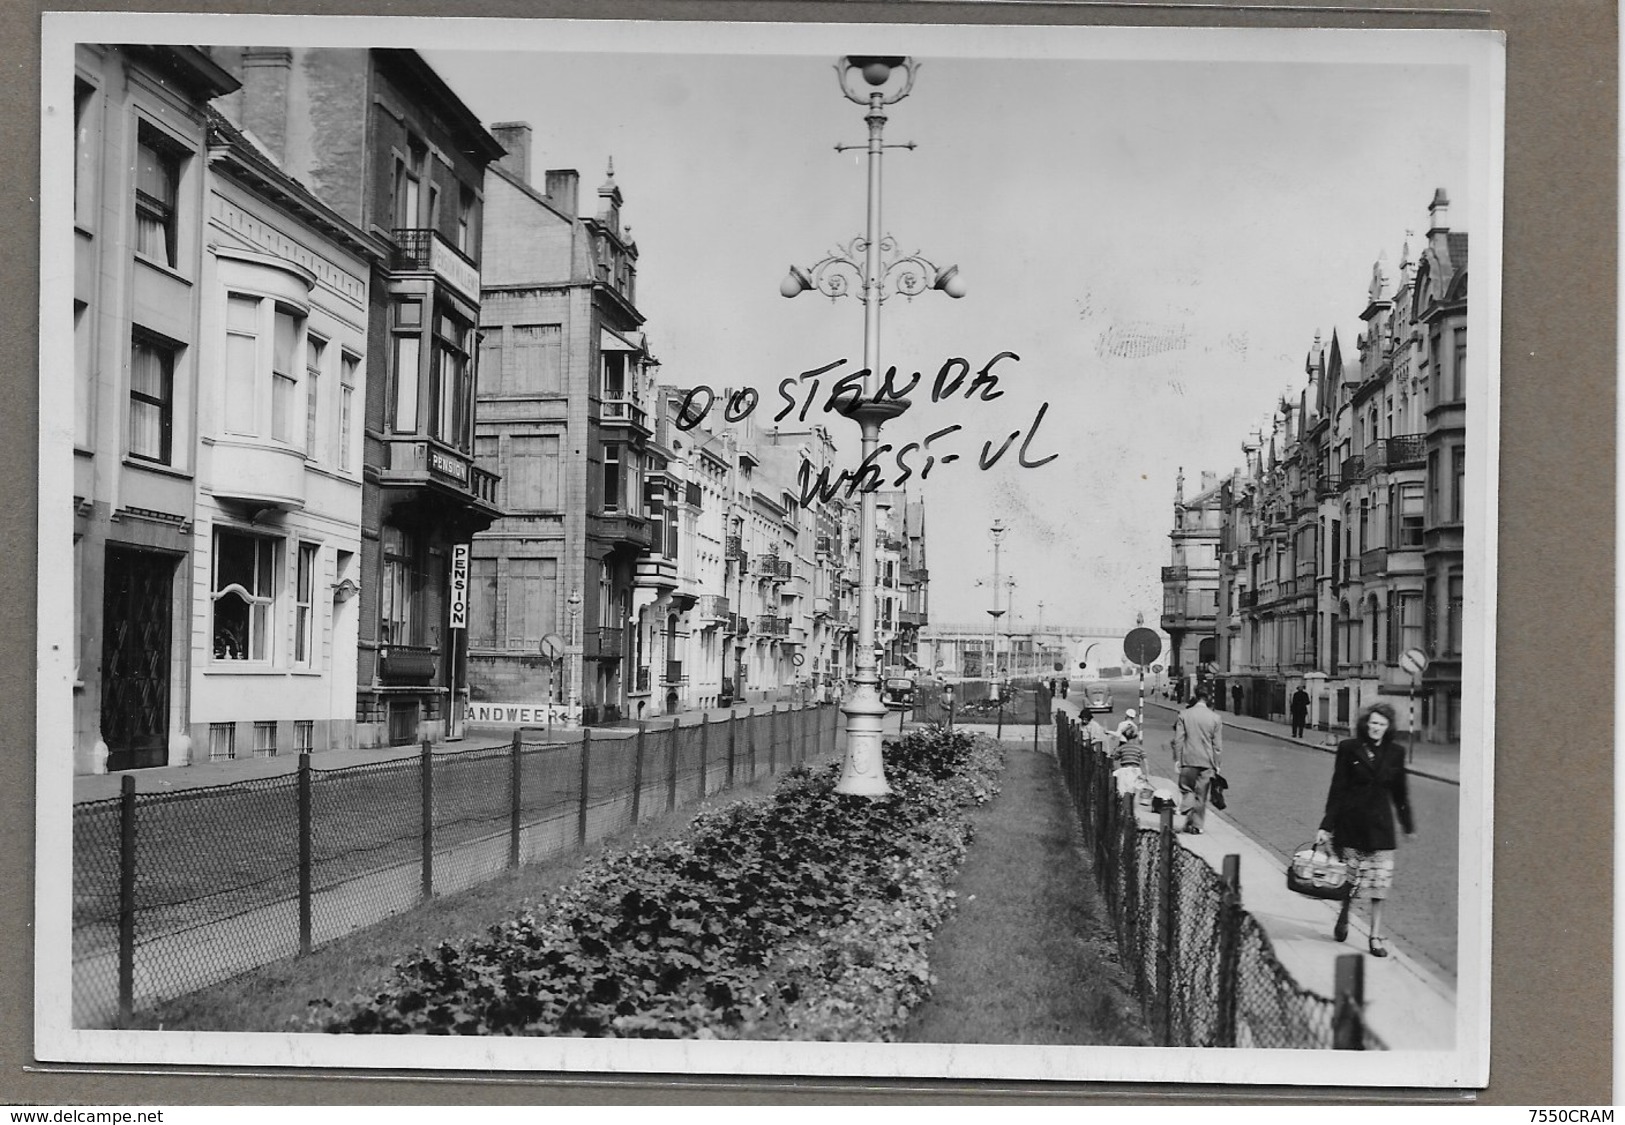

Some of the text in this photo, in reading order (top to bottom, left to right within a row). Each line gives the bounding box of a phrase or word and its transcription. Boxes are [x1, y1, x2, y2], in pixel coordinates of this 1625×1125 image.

[675, 352, 1020, 431] OOSTENDE
[432, 454, 465, 479] PENSION
[452, 547, 466, 624] PENSION
